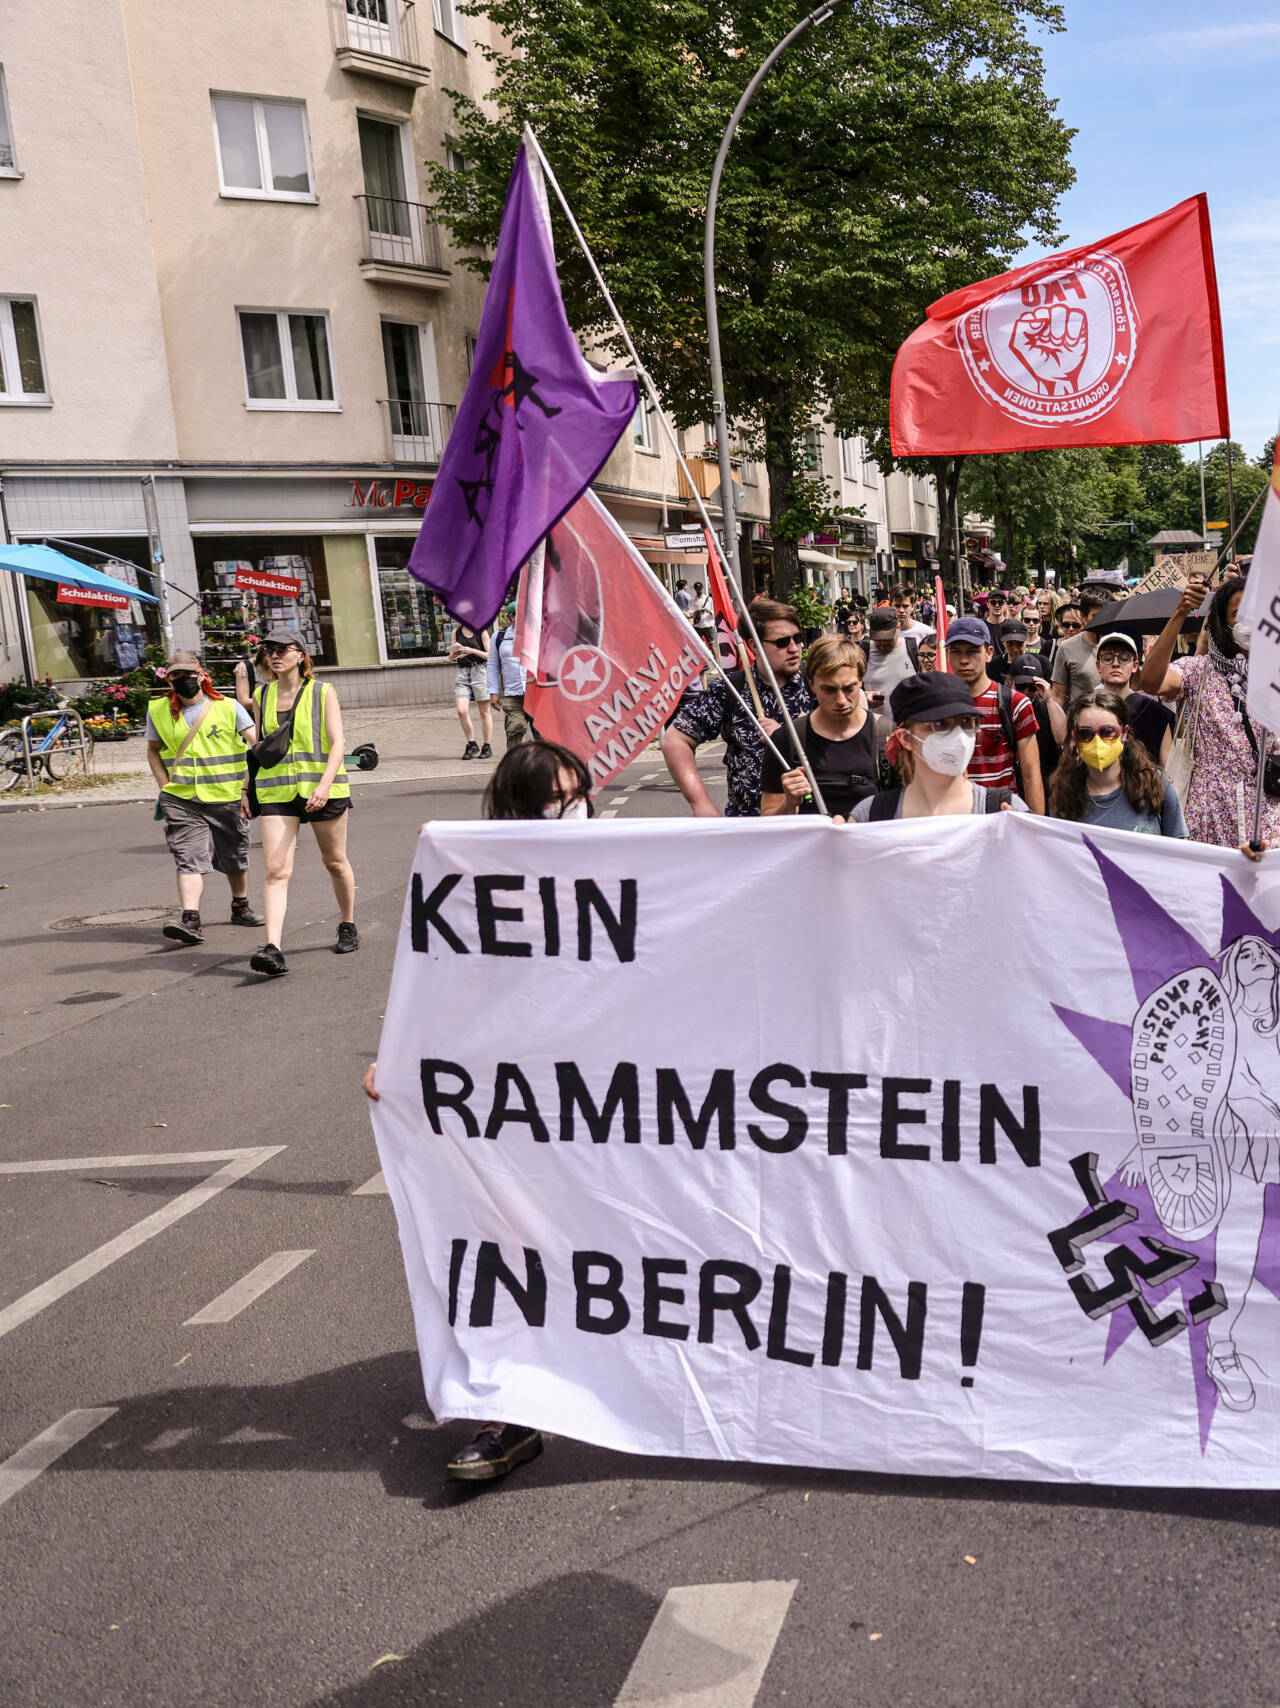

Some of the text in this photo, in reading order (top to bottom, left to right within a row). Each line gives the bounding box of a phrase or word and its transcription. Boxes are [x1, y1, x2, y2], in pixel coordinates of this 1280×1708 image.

[60, 587, 127, 604] Schulaktion
[237, 574, 298, 593] Schulaktion
[411, 873, 637, 962] KEIN
[1143, 977, 1221, 1032] STOMP THE
[1150, 1000, 1210, 1064] PATRIARCHY
[421, 1059, 1040, 1167] RAMMSTEIN
[449, 1239, 546, 1327] IN
